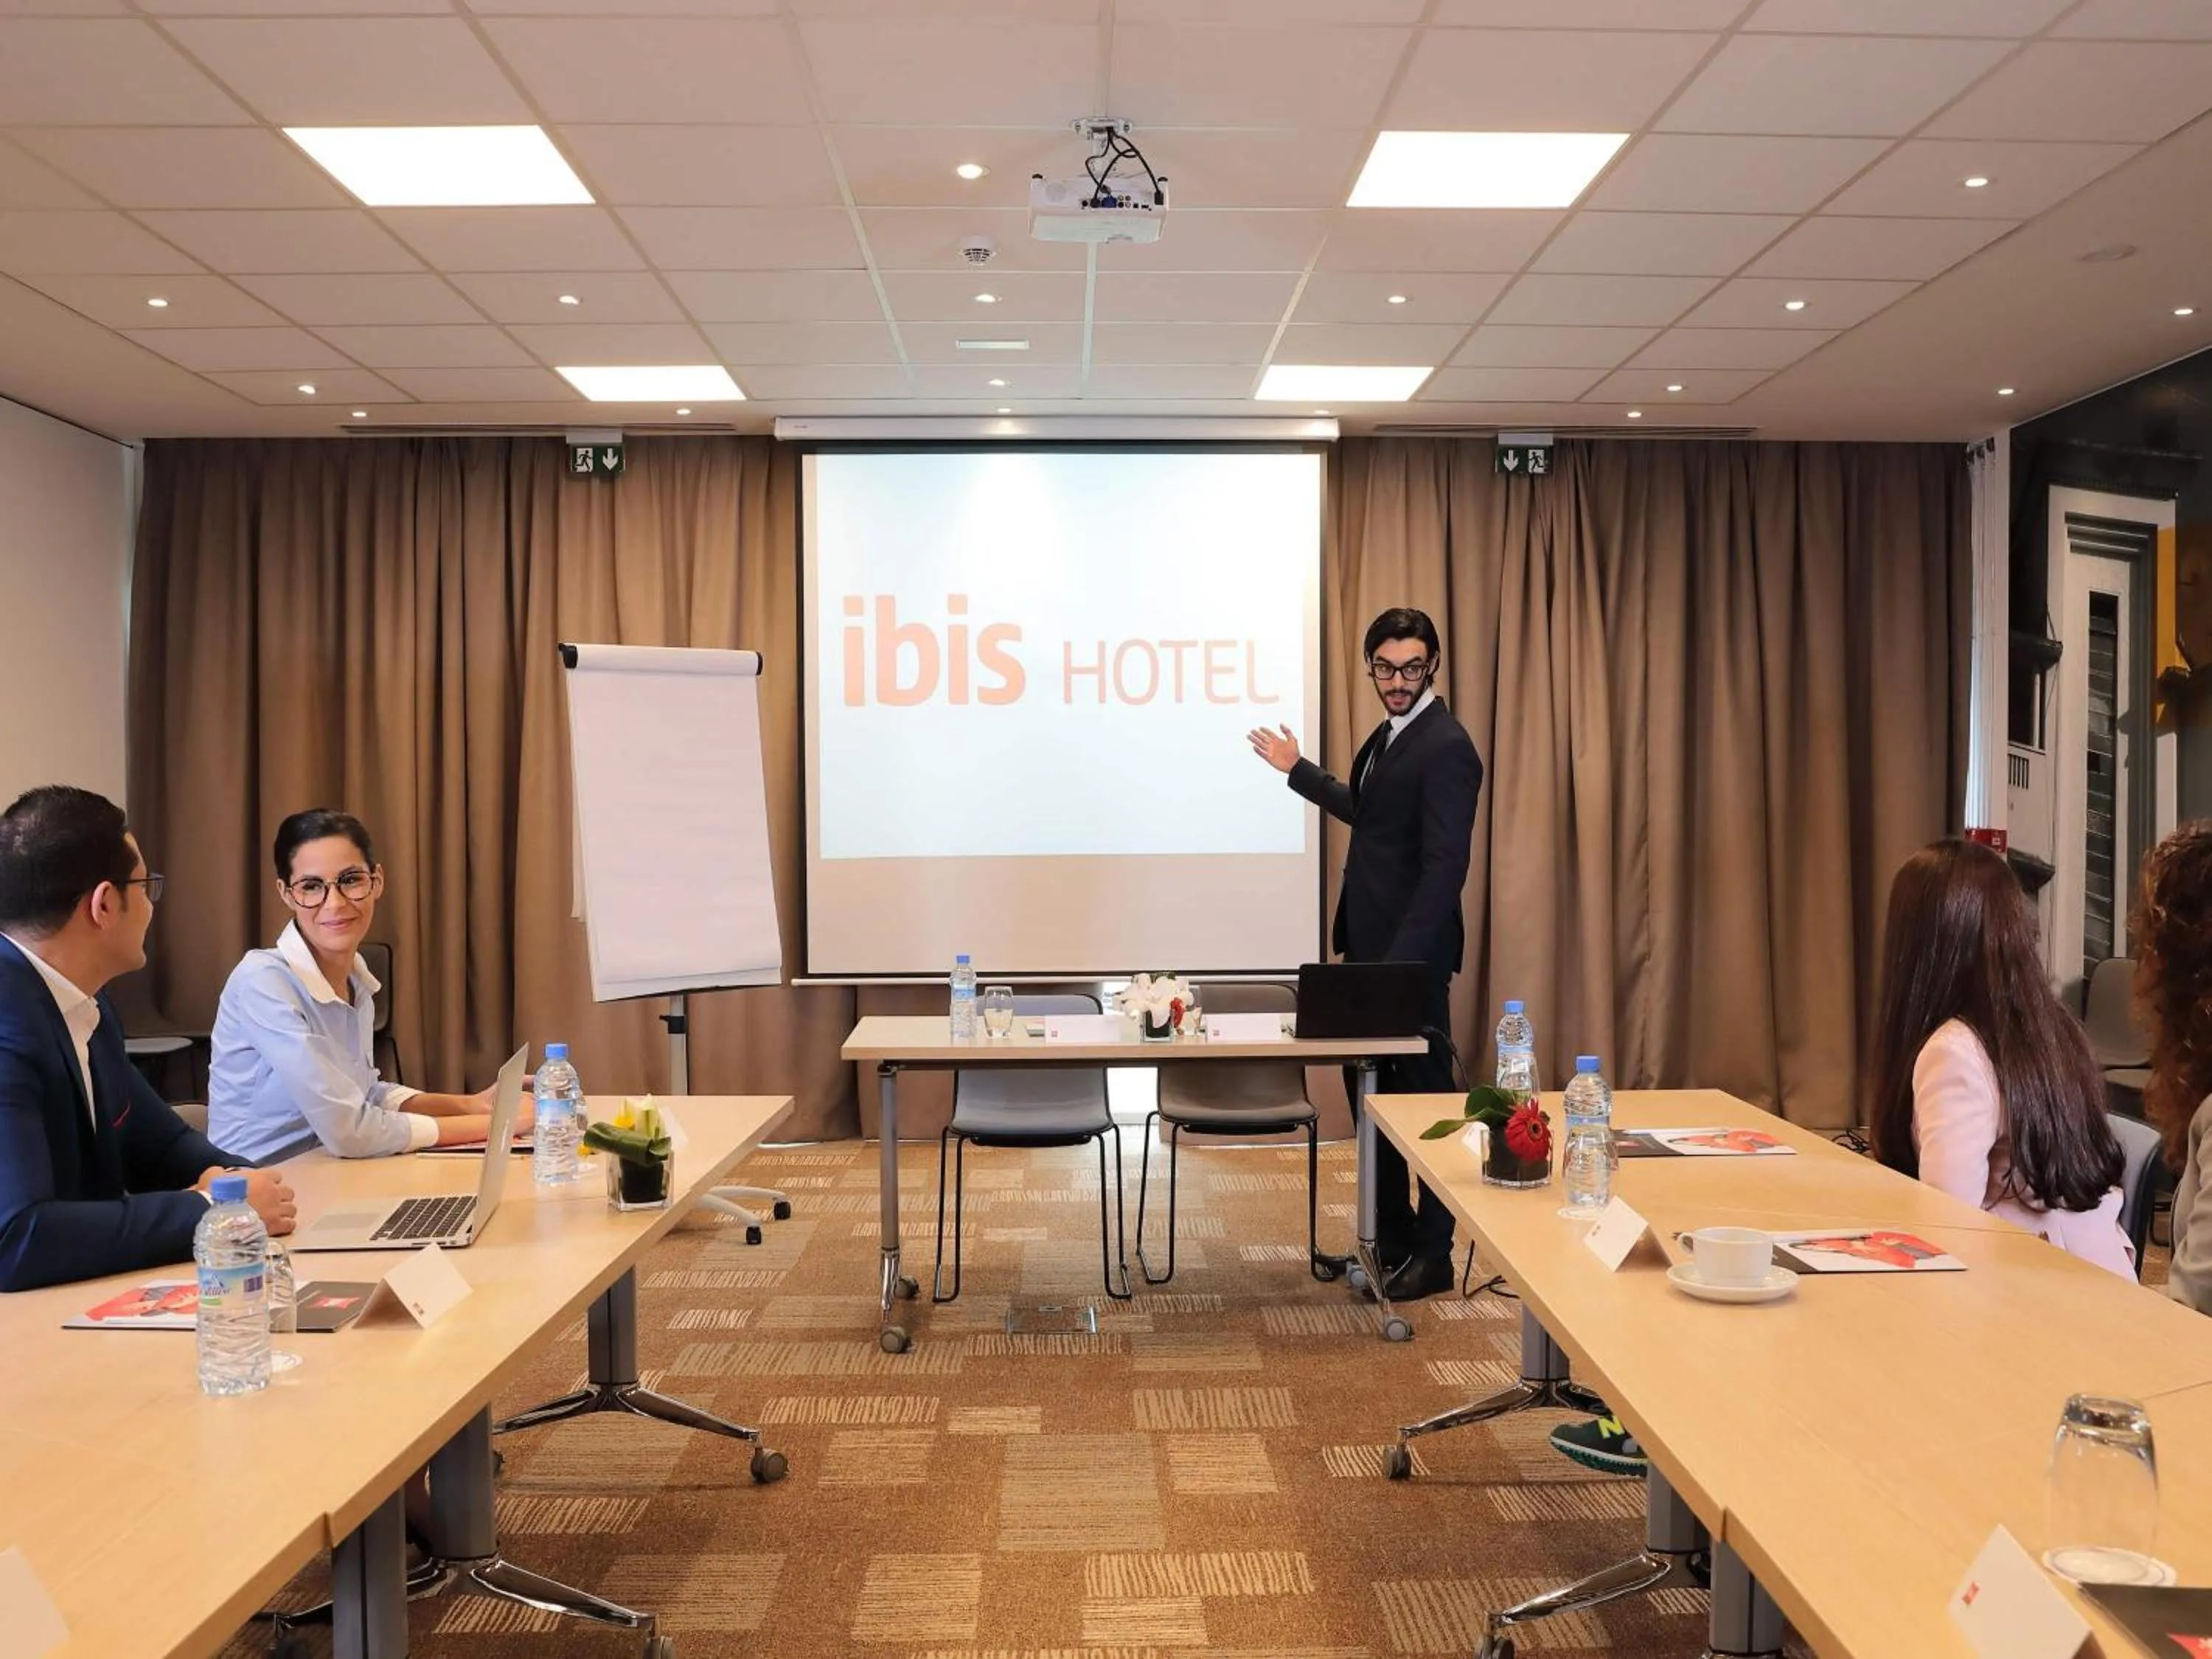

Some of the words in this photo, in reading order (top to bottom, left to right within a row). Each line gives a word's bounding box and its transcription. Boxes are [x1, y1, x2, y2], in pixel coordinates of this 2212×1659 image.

[842, 594, 1026, 707] ibis
[1063, 639, 1280, 706] HOTEL
[1597, 1415, 1625, 1439] N
